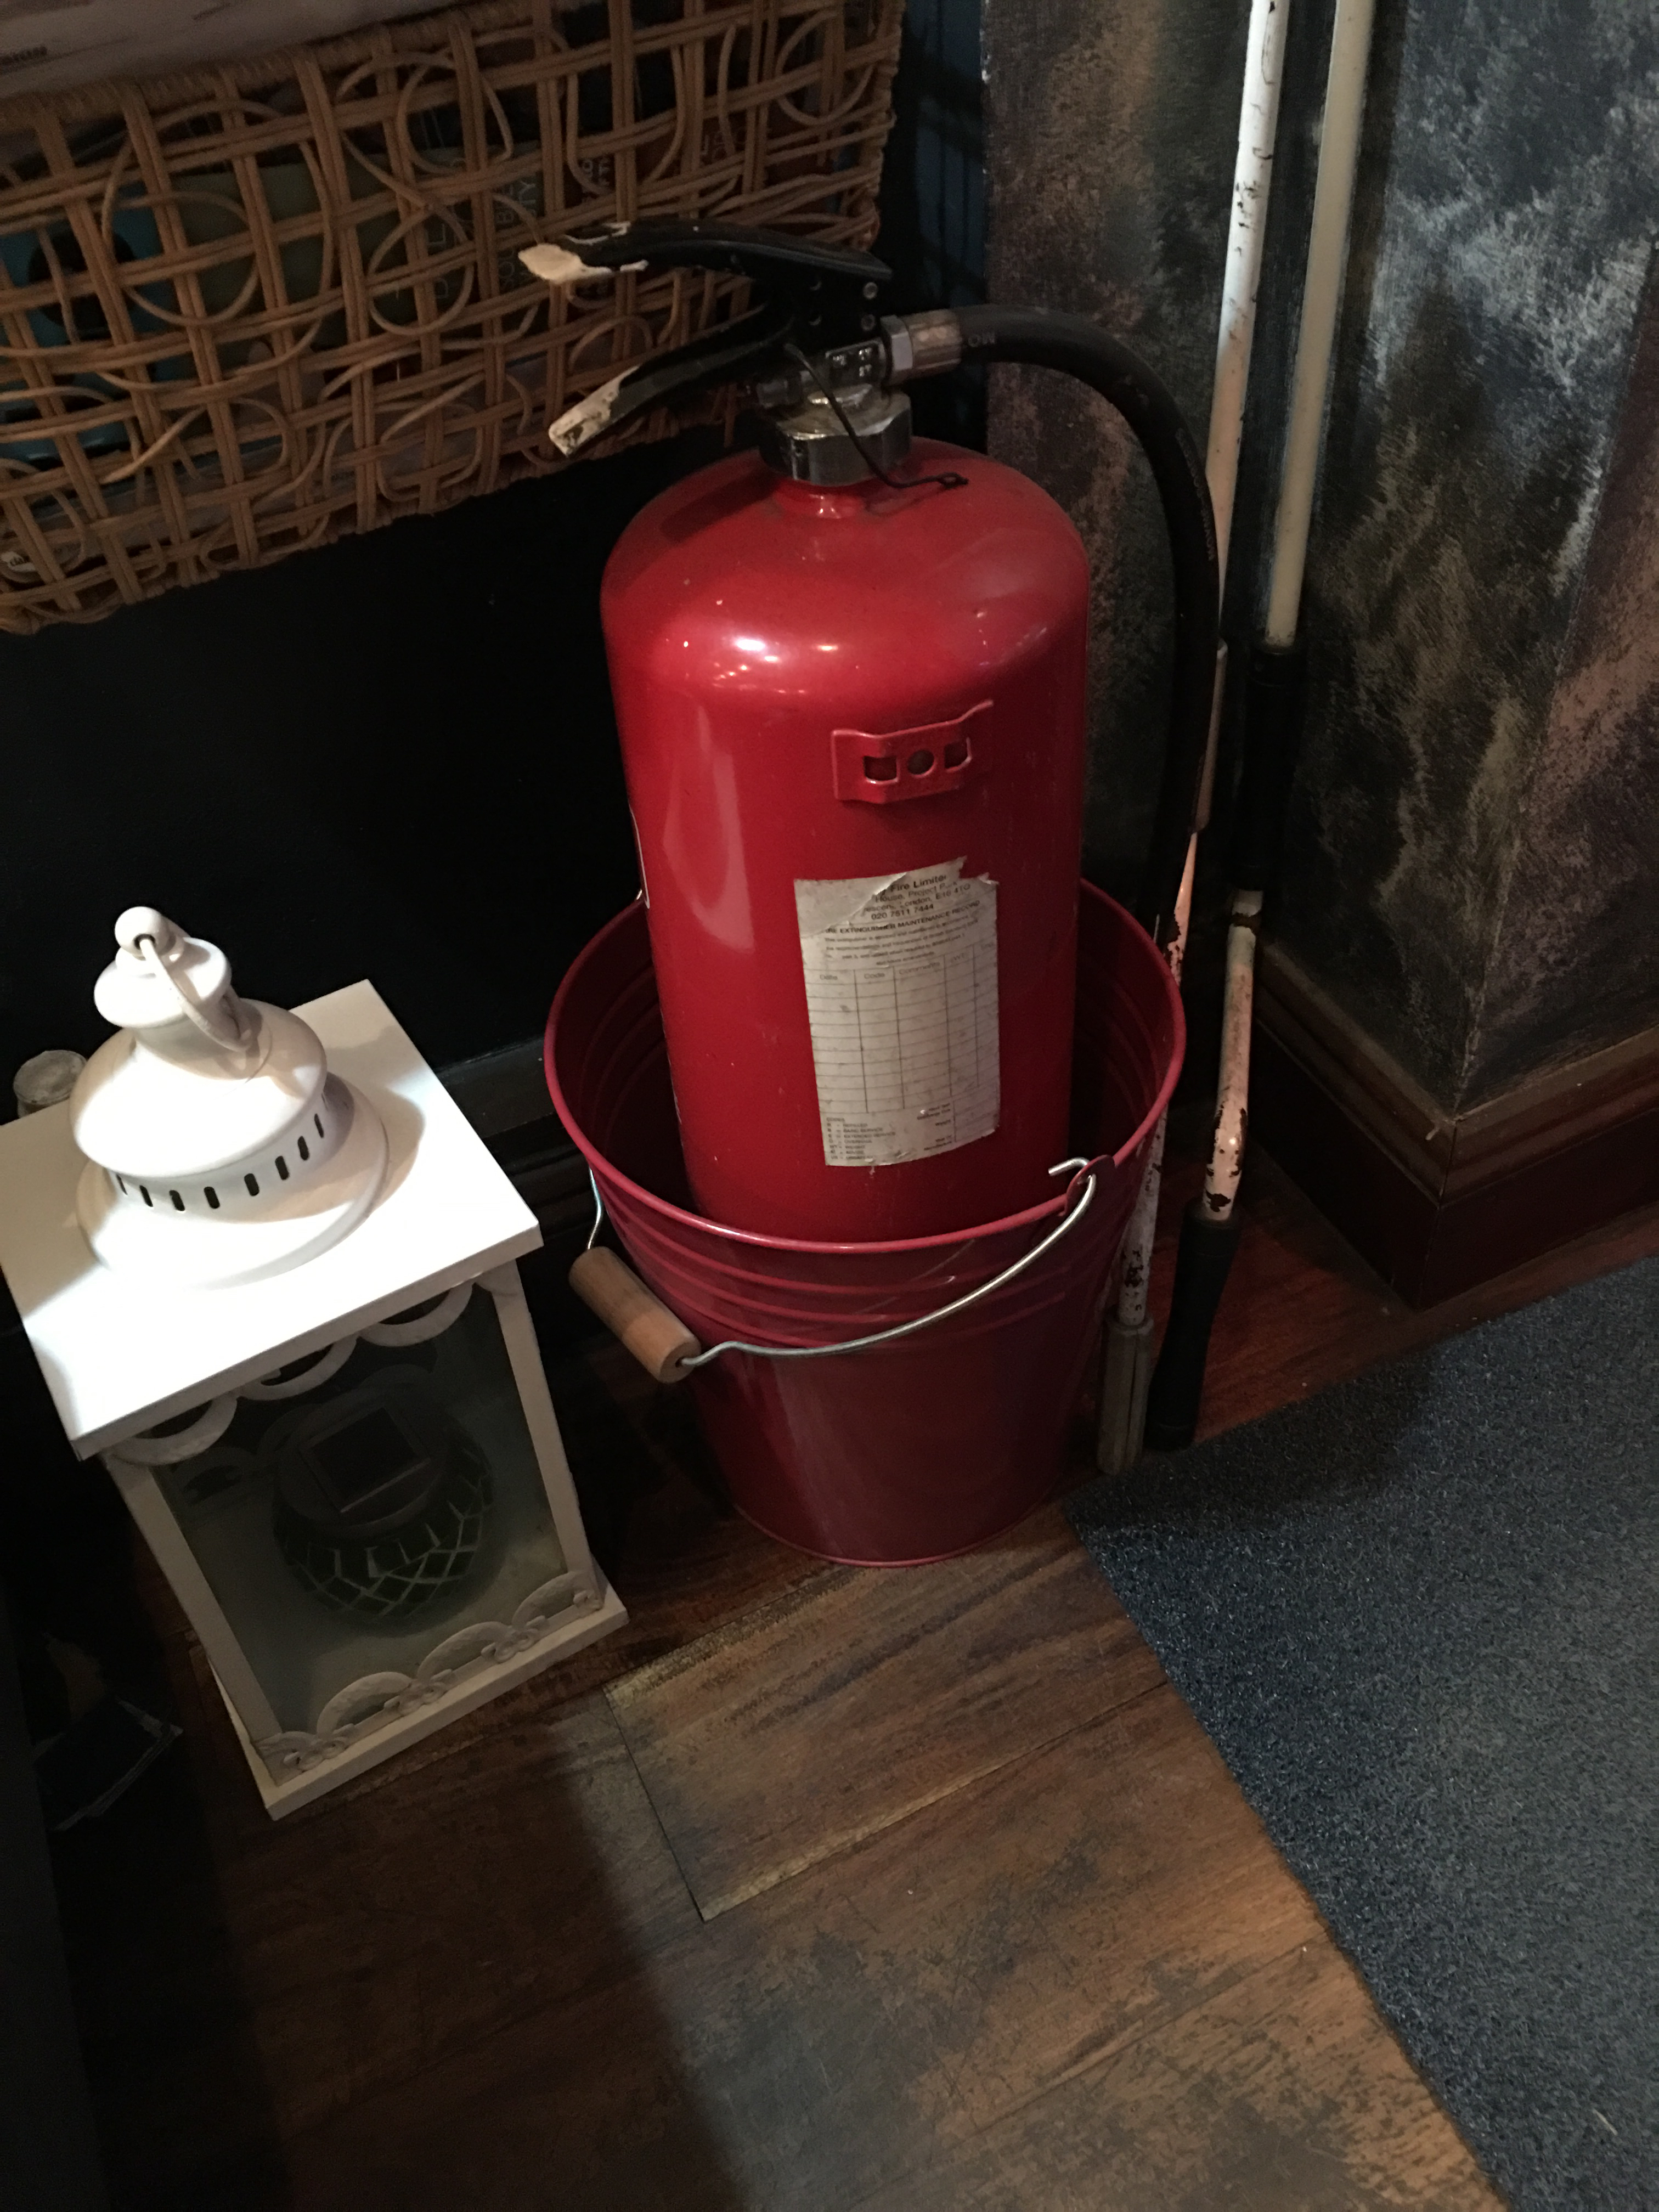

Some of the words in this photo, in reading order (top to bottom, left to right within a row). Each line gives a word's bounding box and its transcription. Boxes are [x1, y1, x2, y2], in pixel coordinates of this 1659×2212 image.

[890, 883, 910, 893] Fire
[909, 885, 937, 898] Project
[939, 881, 957, 890] Pk
[935, 890, 952, 900] E16
[871, 912, 887, 920] 020
[915, 904, 934, 913] 7444
[897, 911, 950, 928] MAINTENANCE
